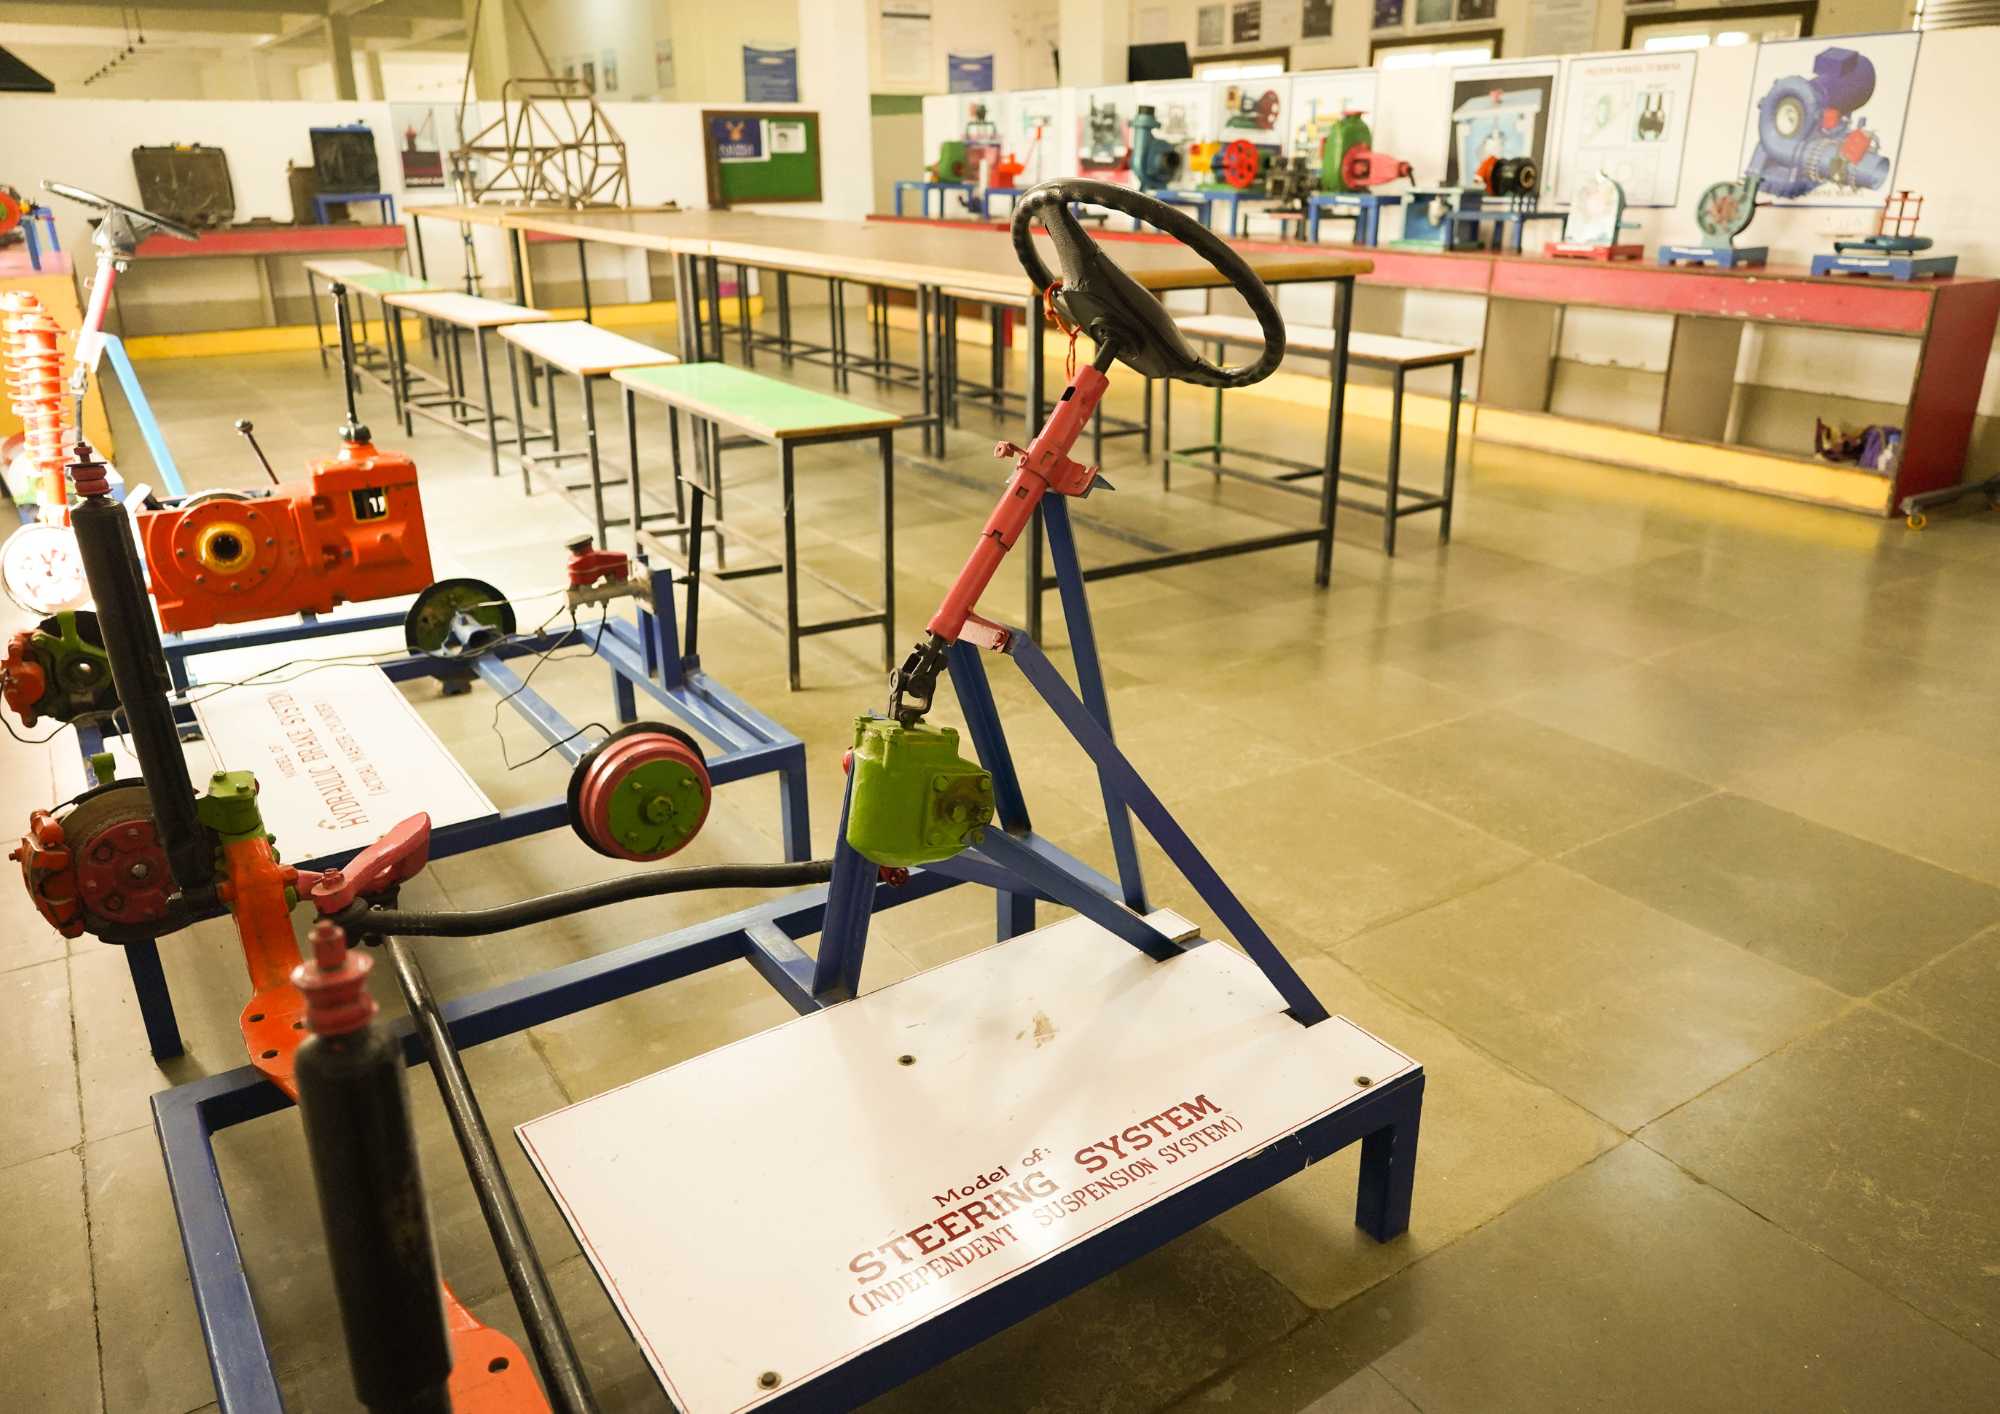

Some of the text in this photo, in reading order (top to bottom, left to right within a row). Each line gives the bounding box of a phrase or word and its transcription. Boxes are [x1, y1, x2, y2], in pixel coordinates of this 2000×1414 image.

[286, 727, 328, 763] BRAKE
[309, 765, 369, 829] HYDRAULIC
[849, 1094, 1222, 1285] STEERING SYSTEM
[849, 1115, 1243, 1317] (INDEPENDENT SUSPENSION SYSTEM)
[932, 1166, 1010, 1207] Model
